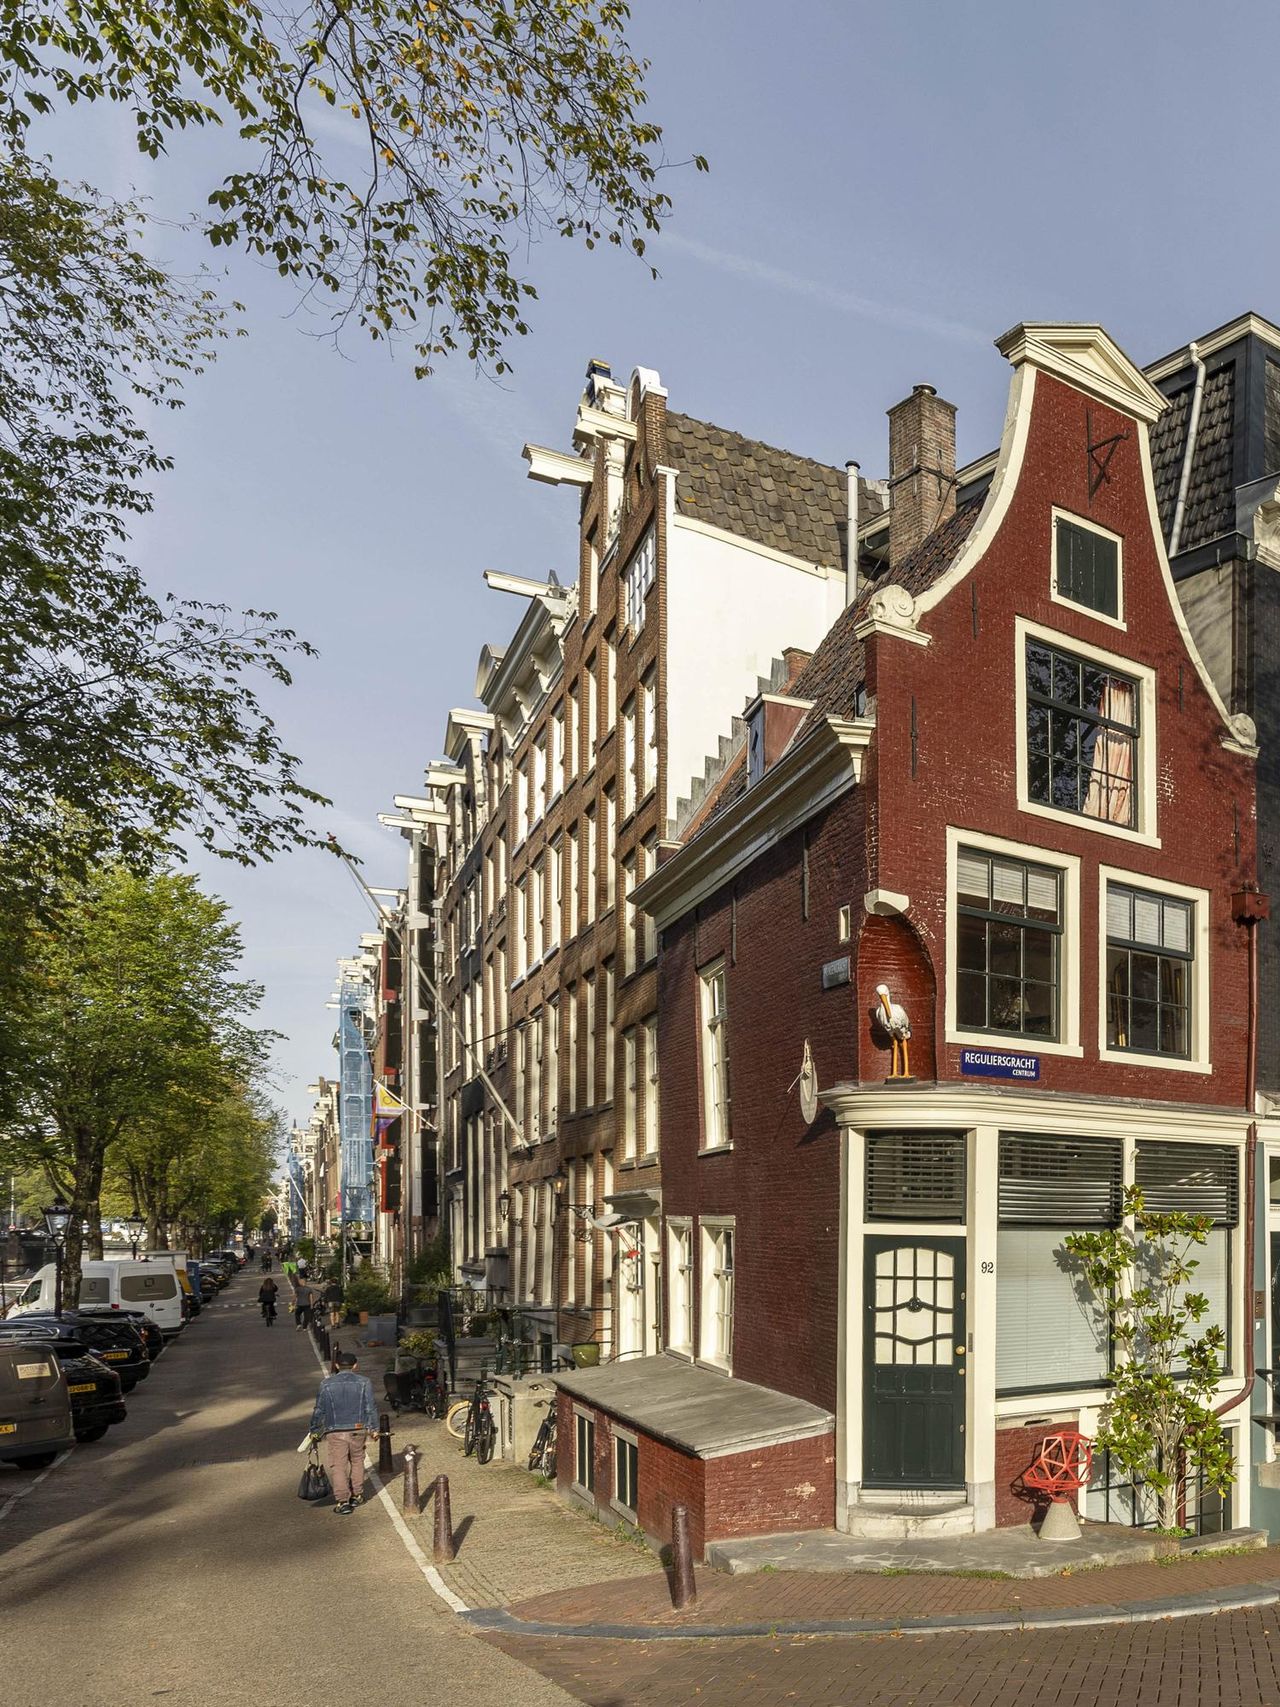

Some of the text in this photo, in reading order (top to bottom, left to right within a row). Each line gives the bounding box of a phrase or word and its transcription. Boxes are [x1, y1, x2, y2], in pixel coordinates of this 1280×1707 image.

[965, 1052, 1036, 1069] REGULIERSGRACHT
[1012, 1069, 1036, 1077] CENTRUM
[981, 1261, 994, 1274] 92
